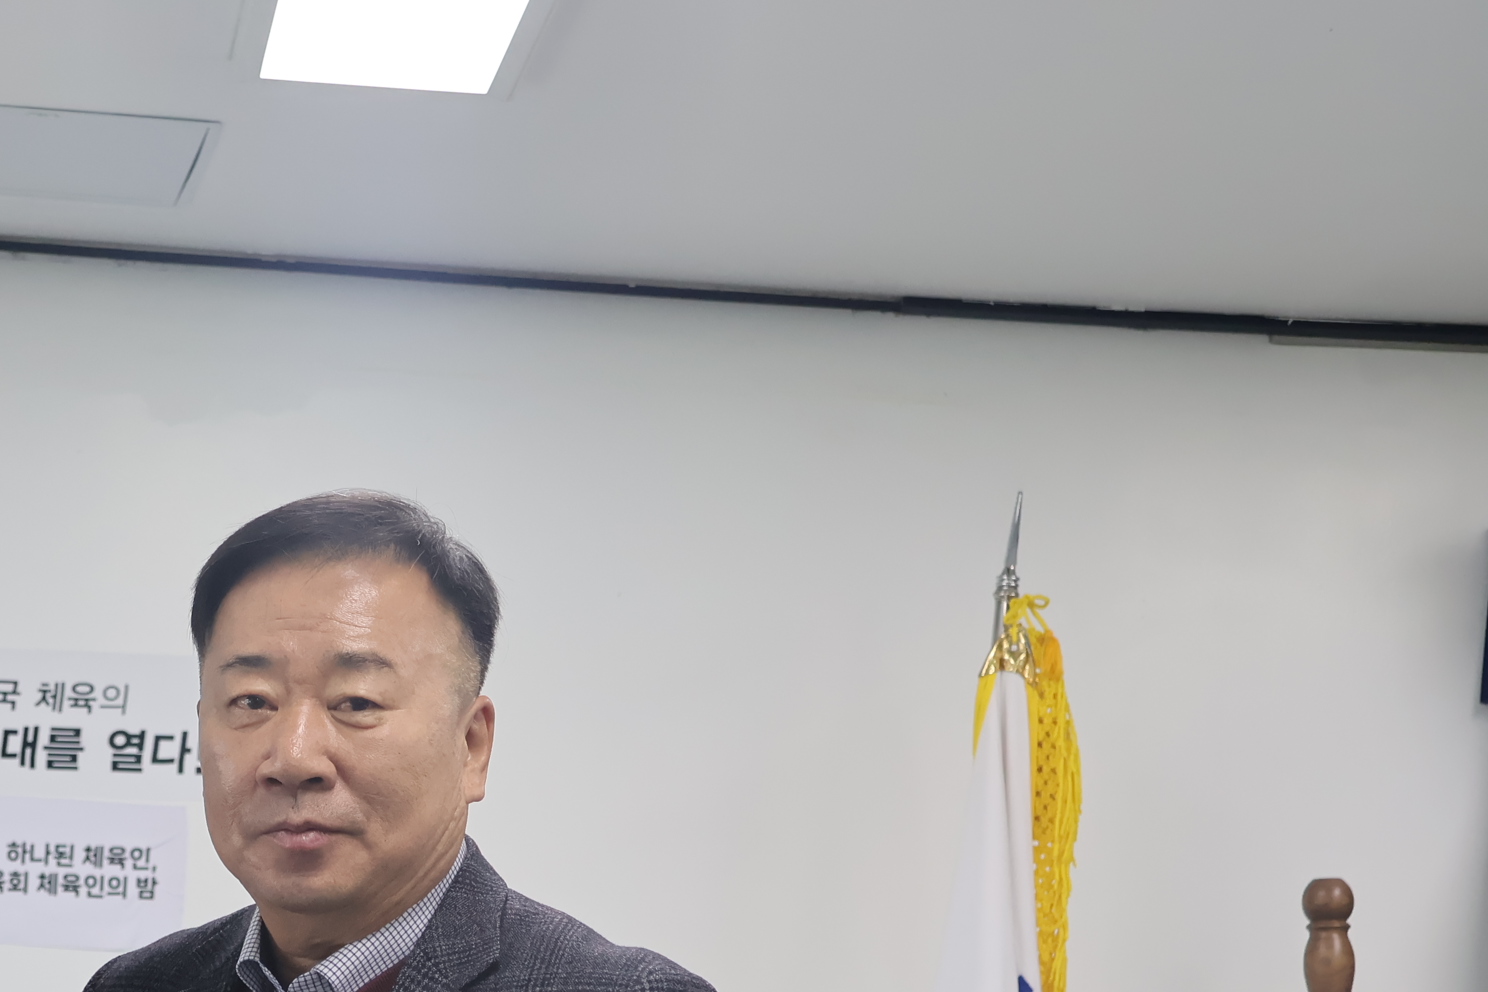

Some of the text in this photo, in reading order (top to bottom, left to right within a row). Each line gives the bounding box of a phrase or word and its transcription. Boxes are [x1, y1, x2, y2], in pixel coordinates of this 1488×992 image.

[35, 681, 130, 715] 체육의
[7, 841, 75, 868] 하나된
[81, 845, 157, 872] 체육인,
[37, 872, 128, 899] 체육인의
[136, 877, 159, 900] 밤
